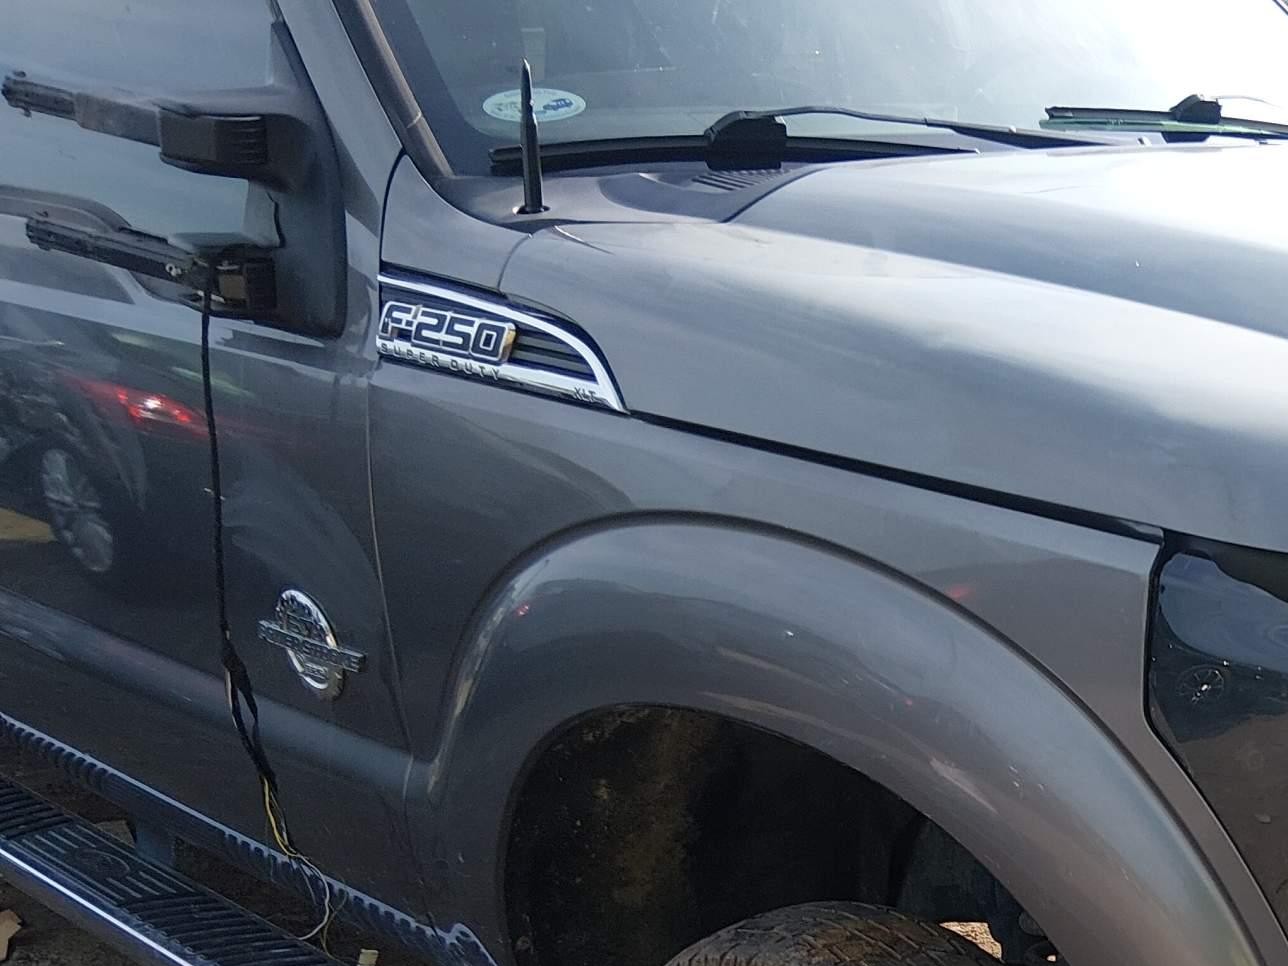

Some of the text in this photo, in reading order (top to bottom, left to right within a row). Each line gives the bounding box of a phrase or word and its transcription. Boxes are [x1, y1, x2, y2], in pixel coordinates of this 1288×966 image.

[379, 300, 508, 362] F-250
[380, 343, 500, 381] SUPER DUTY
